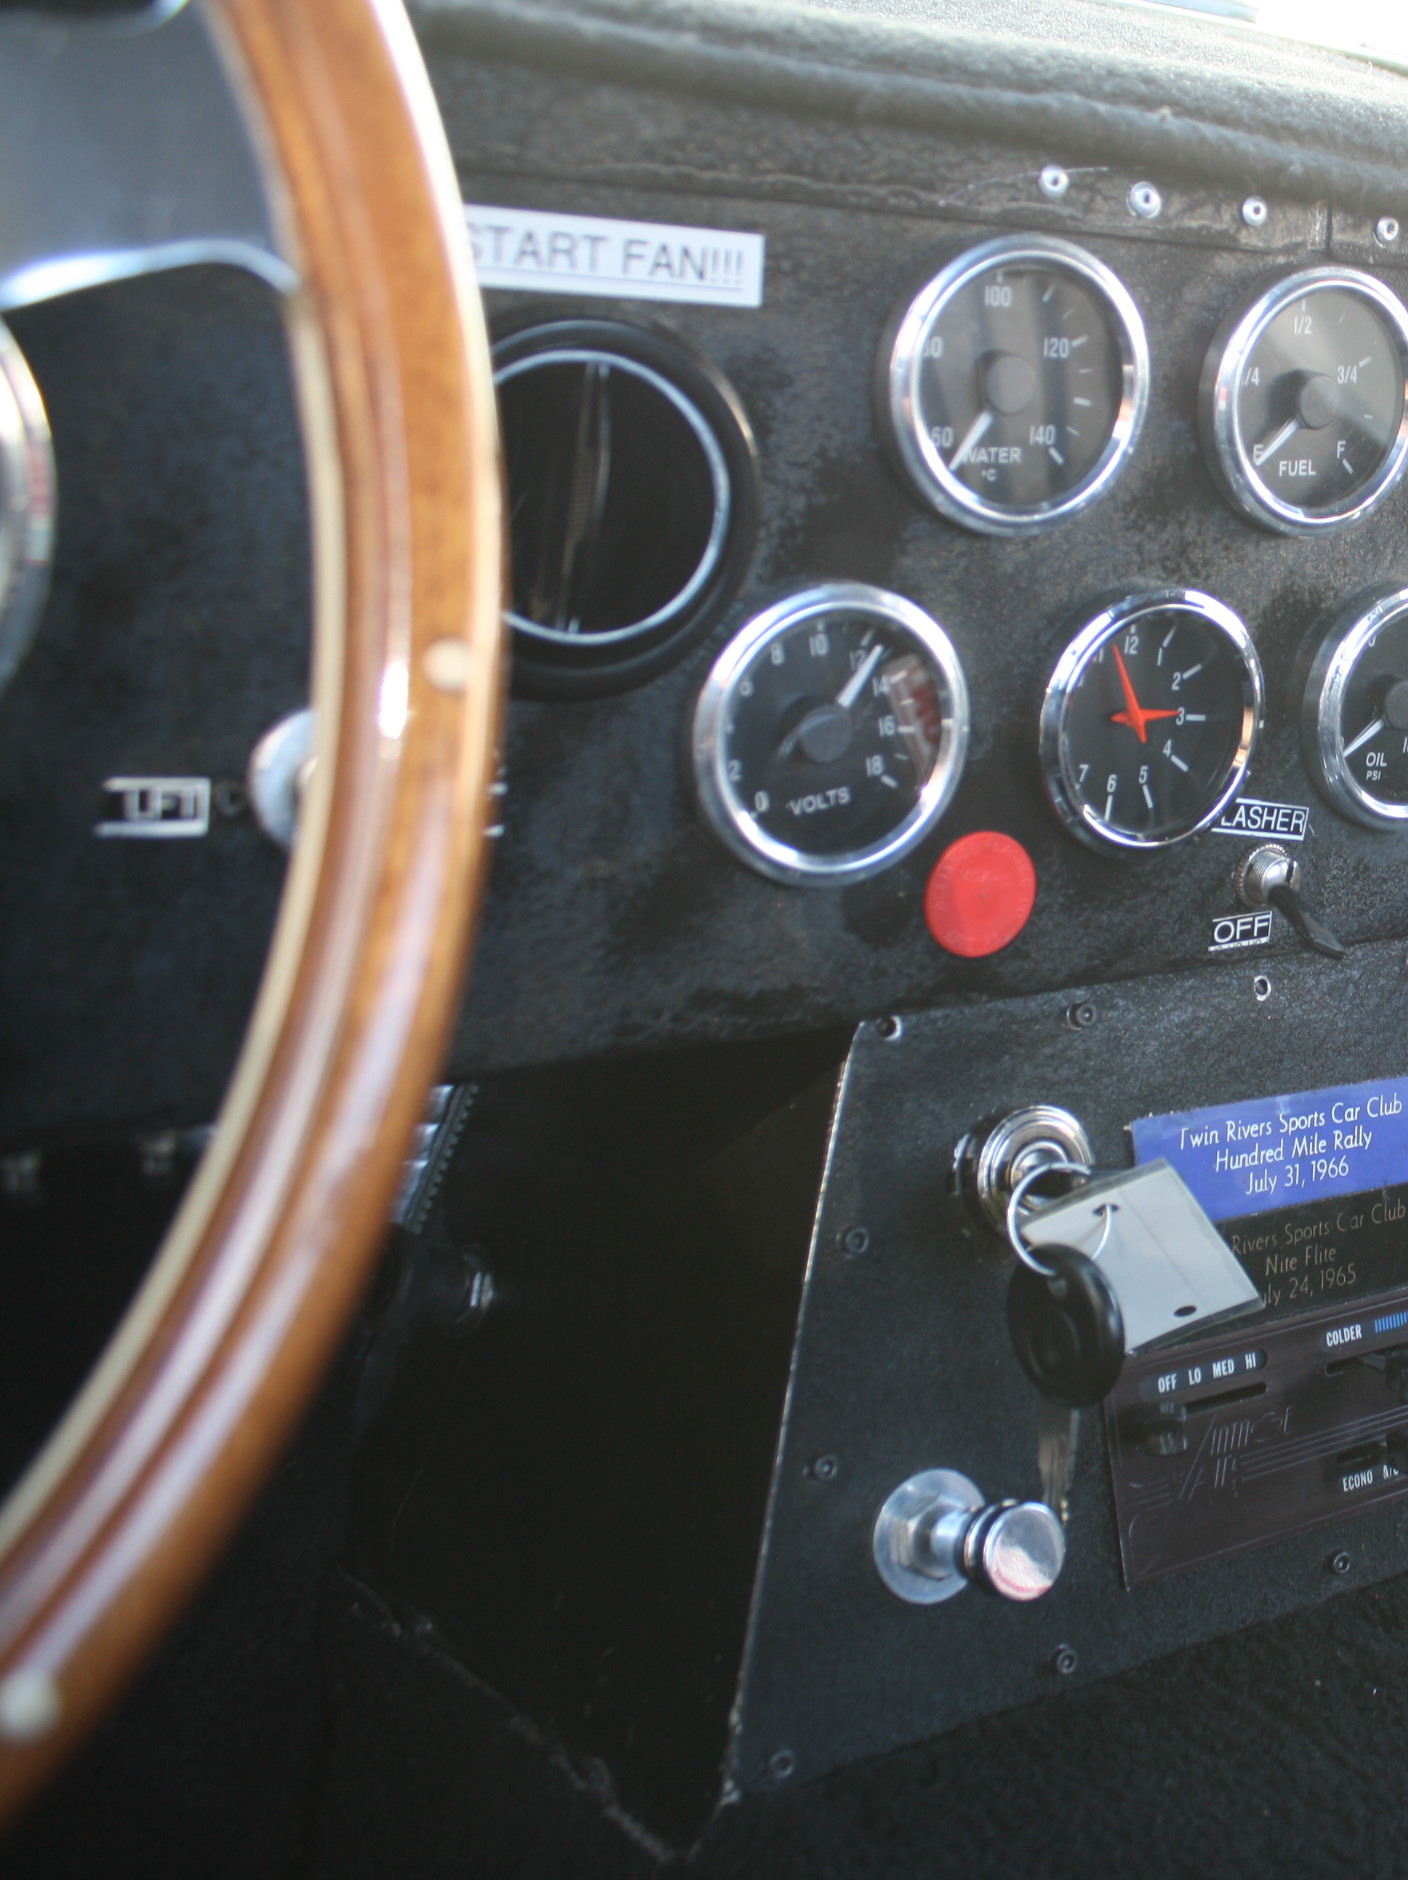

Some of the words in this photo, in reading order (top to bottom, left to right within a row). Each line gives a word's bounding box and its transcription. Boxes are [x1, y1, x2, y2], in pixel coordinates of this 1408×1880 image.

[620, 239, 744, 286] FAN!!!
[984, 285, 1012, 308] 100
[1294, 316, 1312, 335] 1/2
[1044, 337, 1070, 358] 120
[1337, 365, 1358, 384] 3/4
[1030, 425, 1056, 445] 140
[962, 447, 1022, 464] WATER
[1337, 440, 1347, 458] F
[1279, 460, 1316, 477] FUEL
[809, 640, 829, 657] 10
[1124, 636, 1139, 655] 12
[872, 677, 890, 697] 14
[1172, 672, 1181, 690] 2
[1176, 707, 1185, 726] 3
[878, 717, 896, 737] 16
[1163, 739, 1173, 757] 4
[866, 755, 884, 777] 18
[1366, 752, 1387, 768] OIL
[1079, 764, 1089, 782] 7
[1139, 765, 1148, 784] 5
[1366, 771, 1382, 781] PSI
[1107, 774, 1117, 793] 6
[754, 790, 770, 813] 0
[788, 786, 850, 816] VOLTS
[1221, 804, 1306, 833] LASHER
[1213, 913, 1271, 944] OFF
[1180, 1125, 1219, 1150] Twin
[1226, 1118, 1272, 1143] Rivers
[1279, 1109, 1326, 1136] Sports
[1331, 1102, 1361, 1124] Car
[1366, 1093, 1403, 1118] Club
[1215, 1138, 1284, 1173] Hundred
[1292, 1134, 1327, 1158] Mile
[1333, 1125, 1373, 1151] Rally
[1246, 1171, 1278, 1195] July
[1284, 1165, 1305, 1188] 31,
[1311, 1155, 1350, 1182] 1966
[1230, 1231, 1277, 1256] Rivers
[1284, 1221, 1330, 1246] Sports
[1337, 1211, 1365, 1232] Car
[1371, 1199, 1407, 1226] Club
[1265, 1255, 1298, 1277] Nite
[1305, 1246, 1337, 1268] Flite
[1289, 1276, 1314, 1299] 24,
[1320, 1263, 1357, 1290] 1965
[1326, 1324, 1362, 1347] COLDER
[1158, 1374, 1177, 1393] OFF
[1188, 1368, 1202, 1386] LO
[1212, 1358, 1235, 1378] MED
[1245, 1352, 1257, 1371] HI
[1343, 1469, 1374, 1492] ECONO
